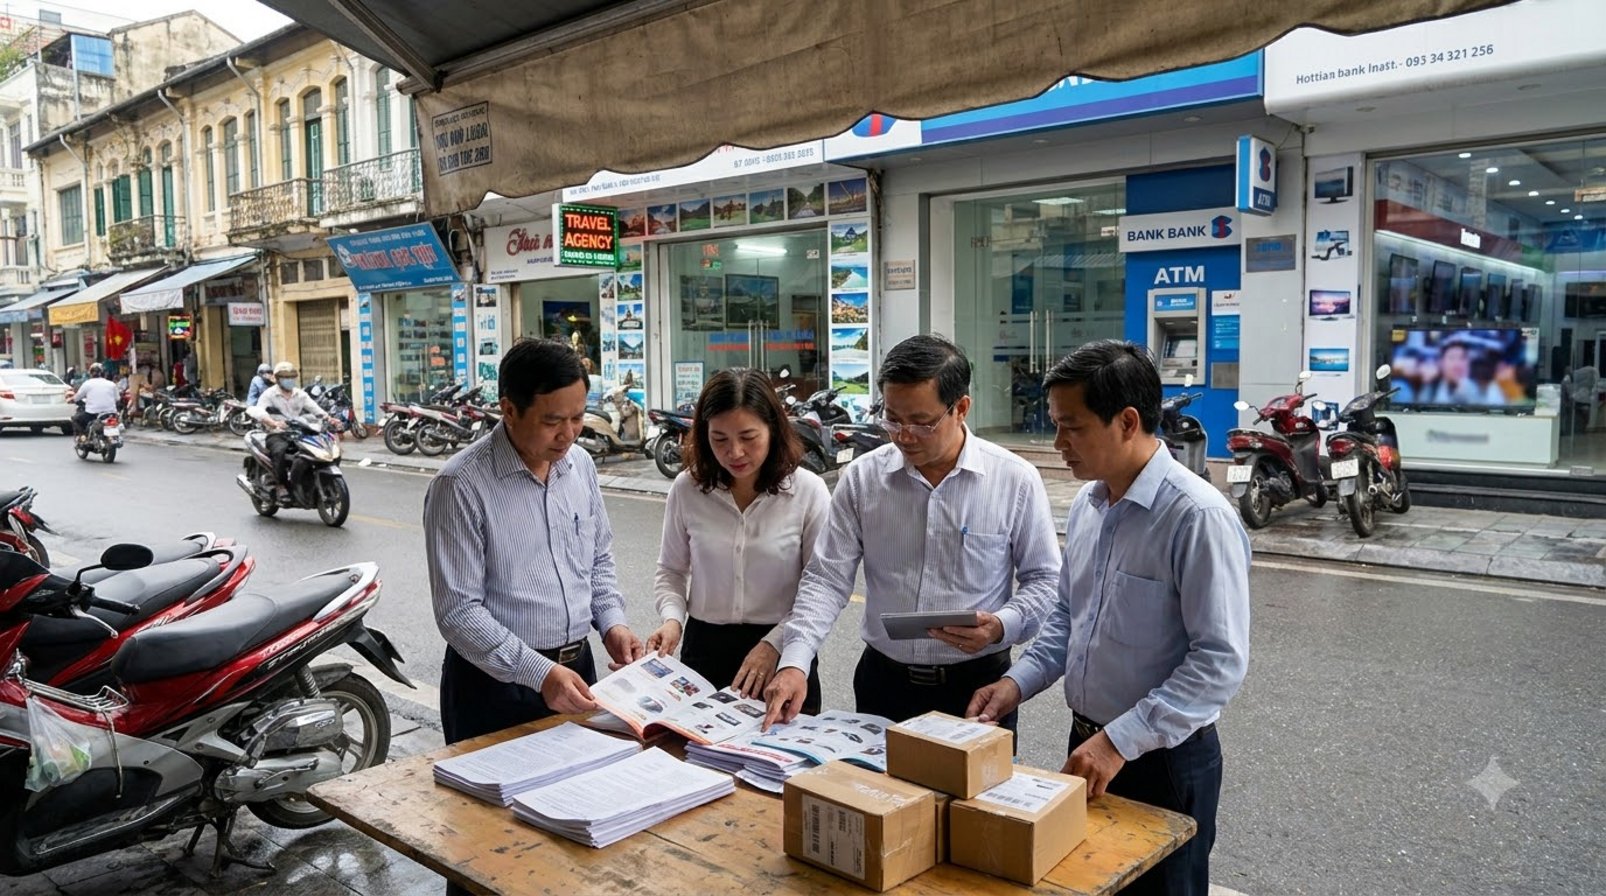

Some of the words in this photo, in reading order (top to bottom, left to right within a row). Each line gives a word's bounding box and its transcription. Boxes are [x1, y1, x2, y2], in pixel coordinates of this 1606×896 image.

[1296, 71, 1336, 85] Hottian
[1338, 65, 1365, 78] bank
[1430, 52, 1444, 64] 34
[1446, 48, 1467, 62] 321
[1471, 43, 1494, 57] 256
[565, 213, 611, 231] TRAVEL
[564, 232, 613, 250] AGENCY
[1127, 229, 1165, 242] BANK
[1168, 225, 1207, 240] BANK
[1153, 265, 1205, 284] ATM
